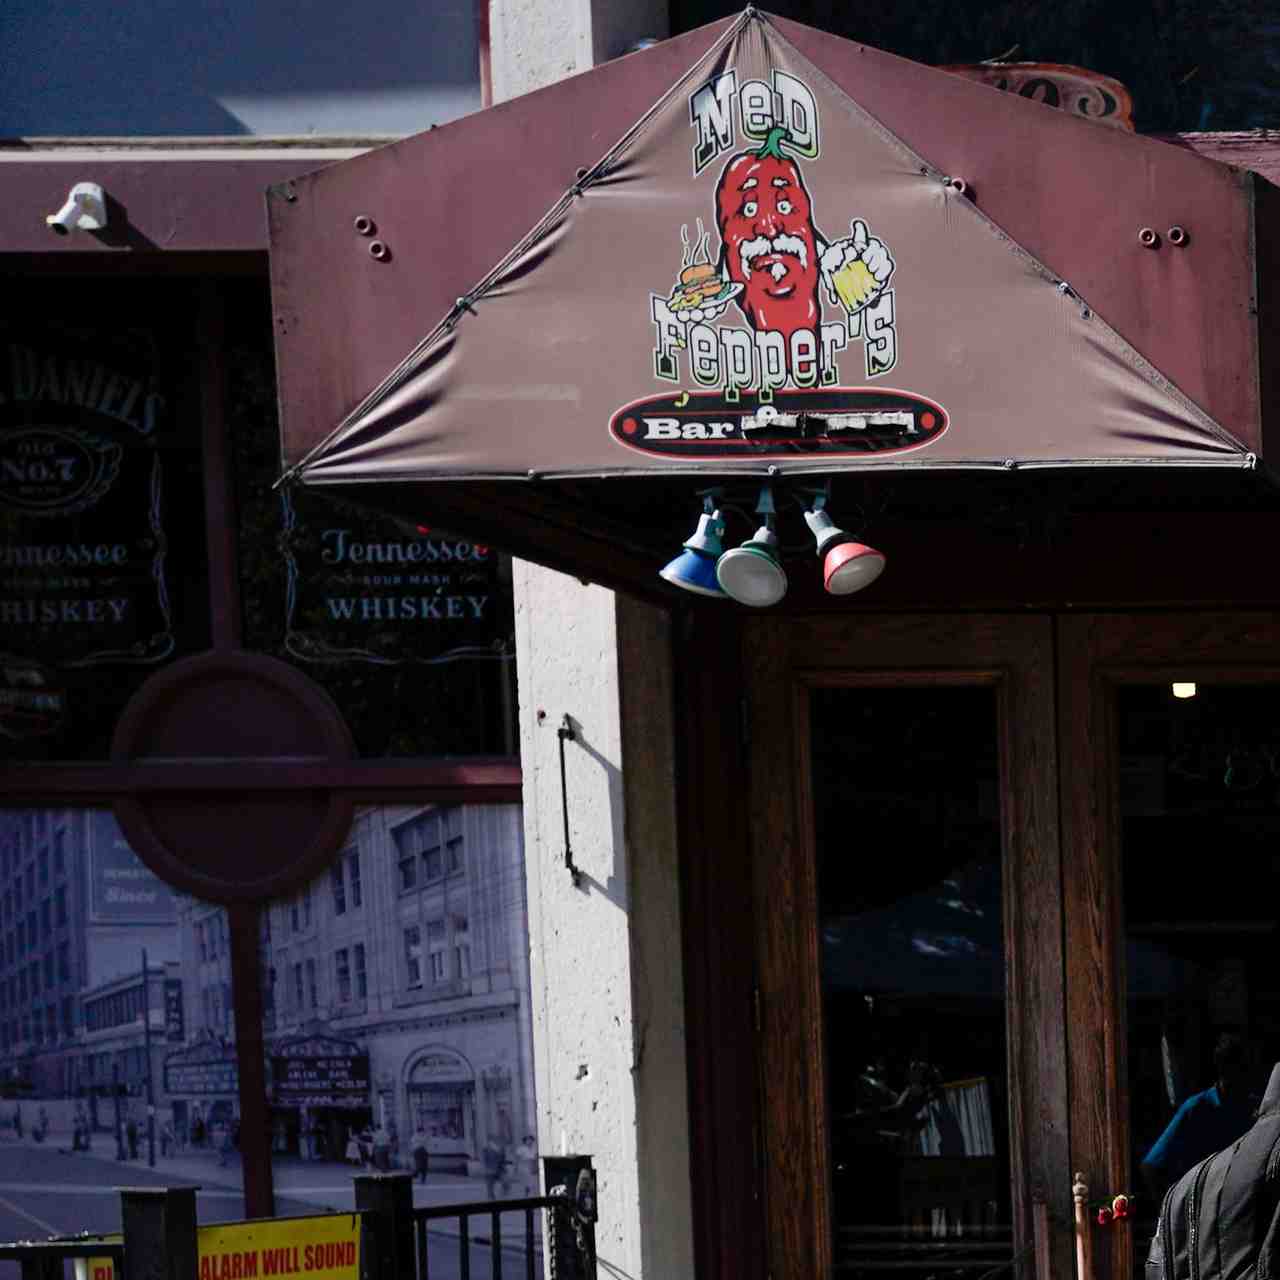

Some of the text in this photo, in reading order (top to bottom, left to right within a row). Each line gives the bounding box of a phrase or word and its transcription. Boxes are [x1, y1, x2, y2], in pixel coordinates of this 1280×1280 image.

[643, 418, 735, 440] Bar
[0, 598, 129, 624] HISKEY
[327, 595, 488, 620] WHISKEY
[263, 1247, 300, 1277] WILL
[304, 1241, 356, 1271] SOUND
